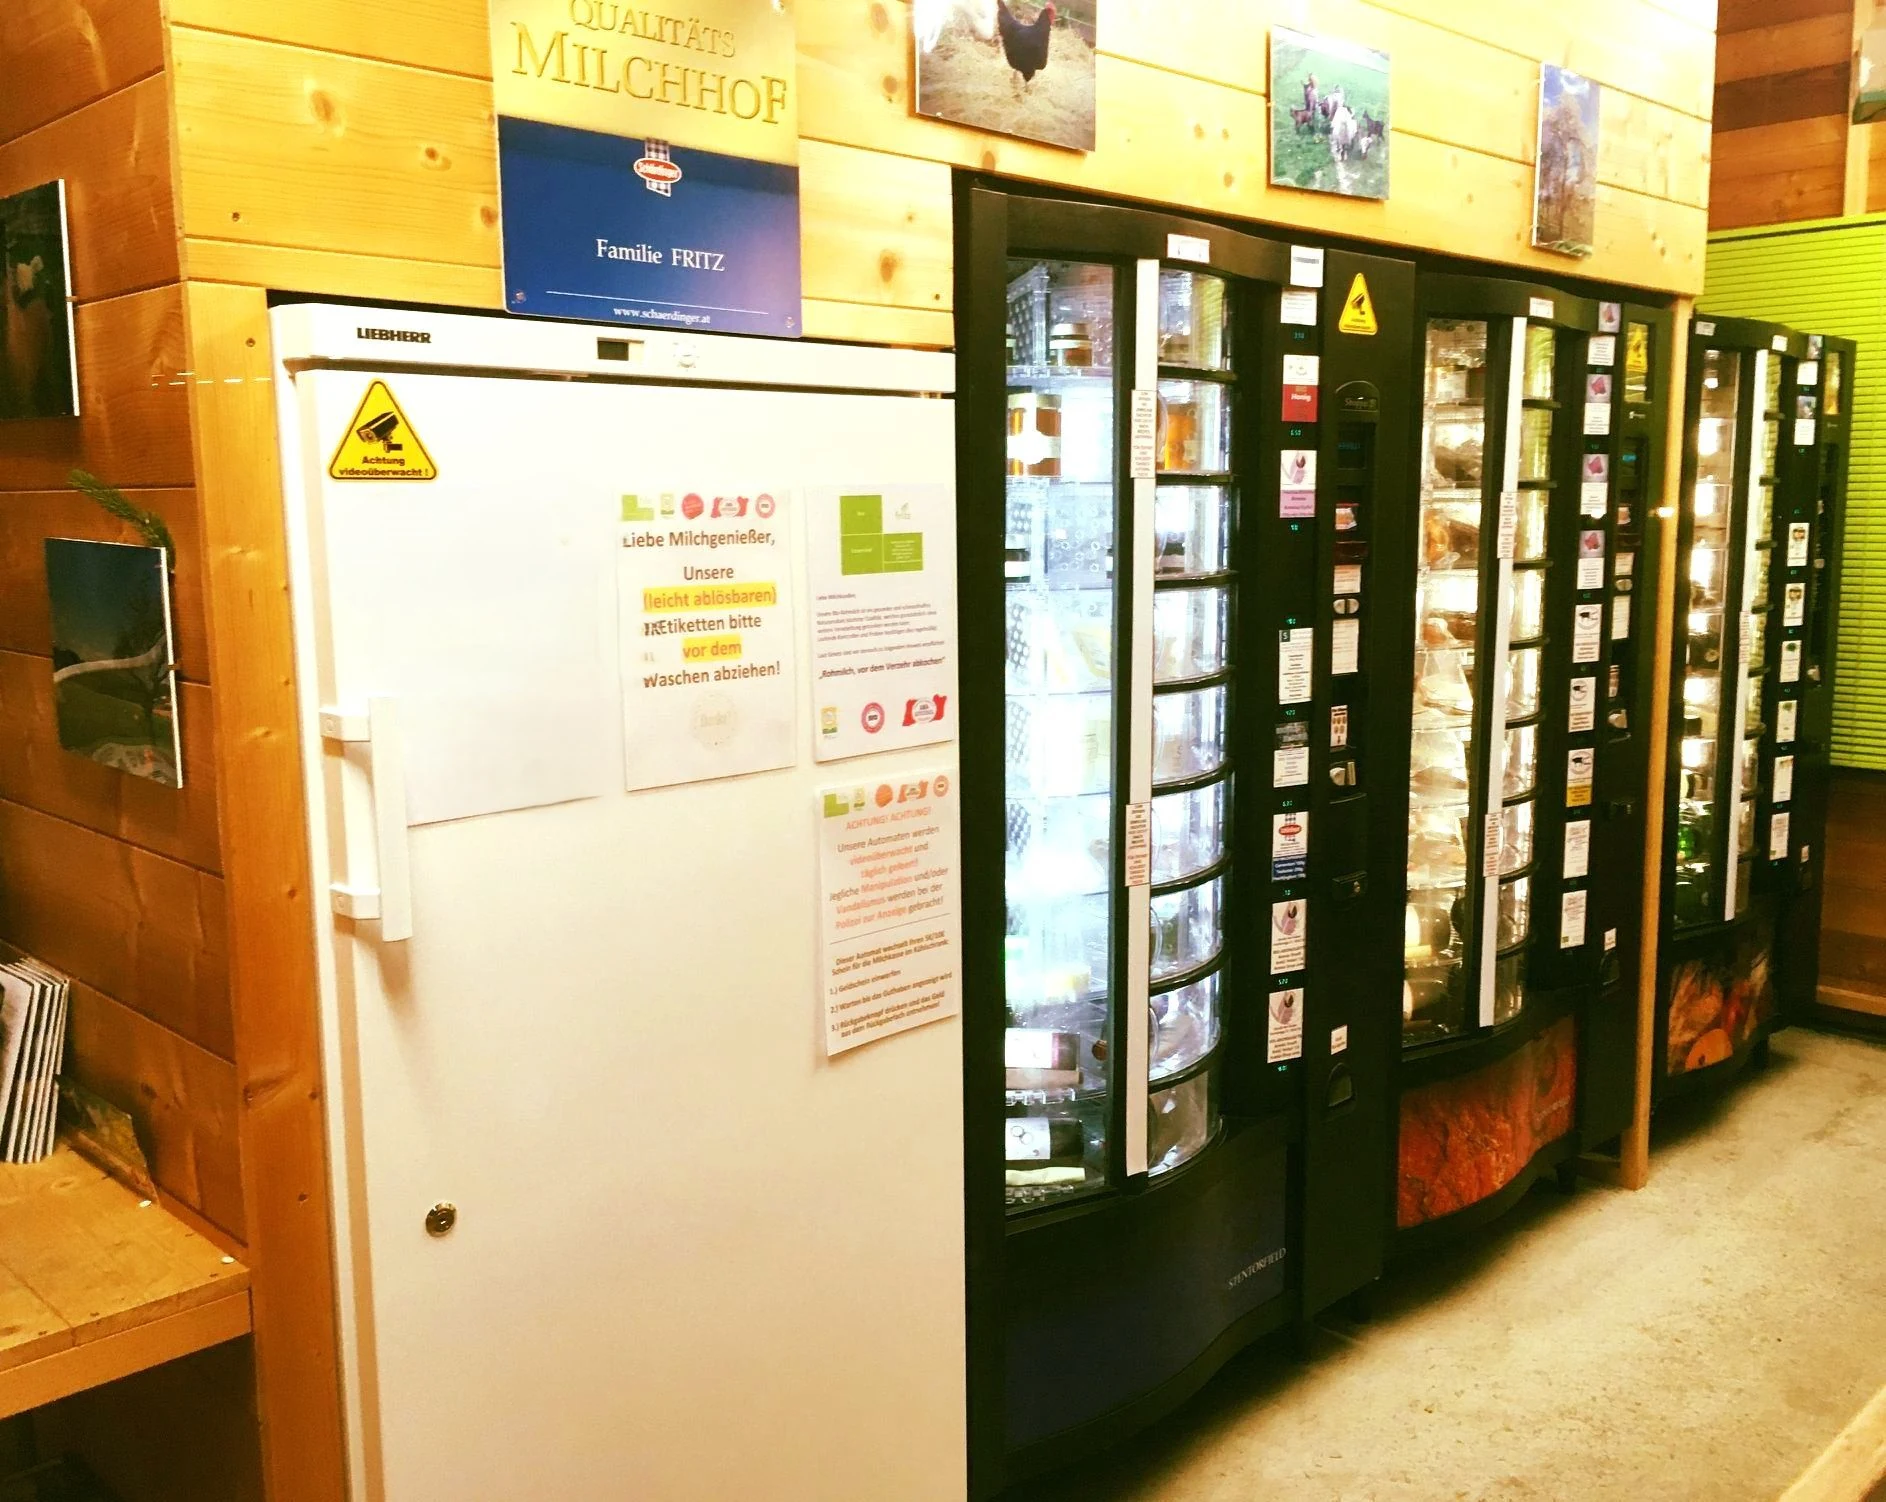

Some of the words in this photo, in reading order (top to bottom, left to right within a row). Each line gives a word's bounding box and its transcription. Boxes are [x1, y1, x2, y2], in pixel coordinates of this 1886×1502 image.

[569, 0, 735, 57] QUALITÄTS
[510, 22, 786, 124] MILCHHOF
[596, 238, 663, 264] Familie
[671, 248, 725, 272] FRITZ
[613, 306, 711, 325] www.schaerdinger.at
[356, 327, 432, 344] LIEBHERR
[361, 455, 406, 466] Achtung
[338, 467, 422, 477] videoüberwacht
[622, 532, 665, 548] Liebe
[669, 529, 775, 549] Milchgenießer,
[683, 566, 734, 580] Unsere
[643, 592, 690, 611] (leicht
[693, 586, 778, 606] ablösbaren)
[729, 615, 762, 629] bitte
[682, 645, 708, 658] vor
[710, 641, 742, 656] dem
[643, 670, 709, 688] Waschen
[714, 661, 780, 682] abziehen!
[837, 840, 866, 853] Unsere
[867, 831, 910, 847] Automaten
[912, 825, 940, 837] werden
[913, 841, 929, 853] und
[886, 890, 916, 902] werden
